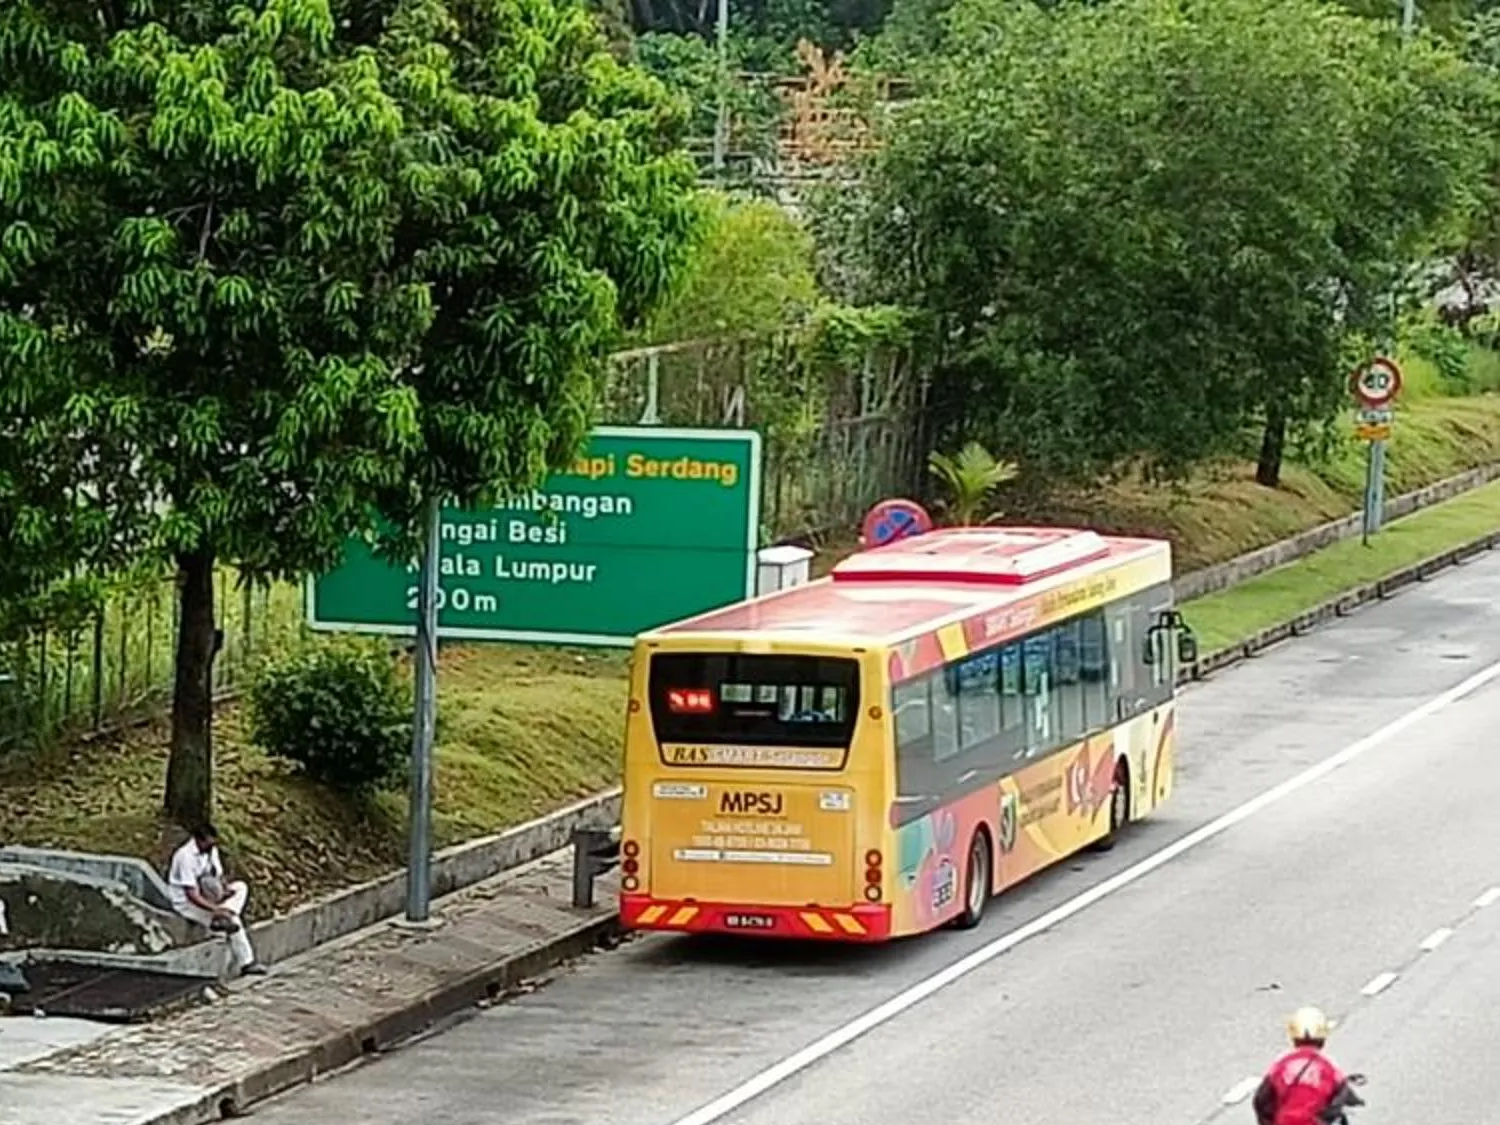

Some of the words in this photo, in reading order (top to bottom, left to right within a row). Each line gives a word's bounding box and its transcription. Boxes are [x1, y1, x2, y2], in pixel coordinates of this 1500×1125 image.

[626, 454, 737, 486] Serdang
[509, 519, 567, 544] Besi
[495, 555, 597, 584] Lumpur
[720, 792, 783, 815] MPSJ
